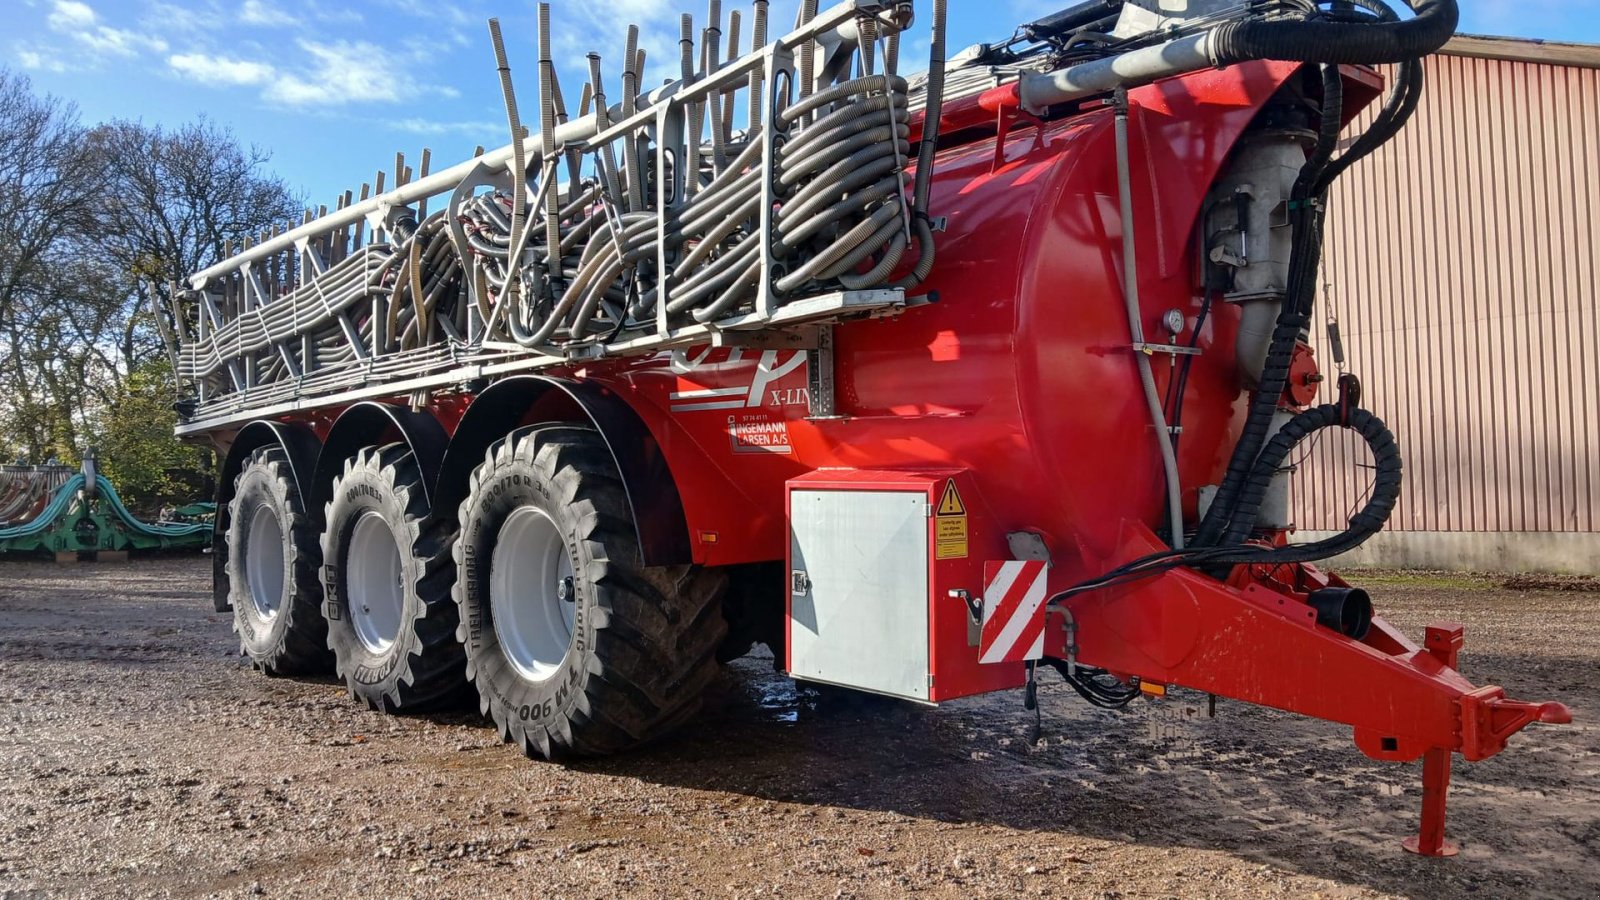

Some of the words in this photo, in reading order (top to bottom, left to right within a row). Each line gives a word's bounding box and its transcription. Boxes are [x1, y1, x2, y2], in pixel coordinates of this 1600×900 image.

[770, 388, 810, 406] X-LIN
[737, 422, 786, 434] INGEMANN
[738, 434, 771, 445] LARSEN
[773, 434, 788, 444] A/S
[464, 544, 481, 651] TRELLEBORG
[568, 529, 585, 652] TRELLEBORG
[520, 698, 552, 721] 900
